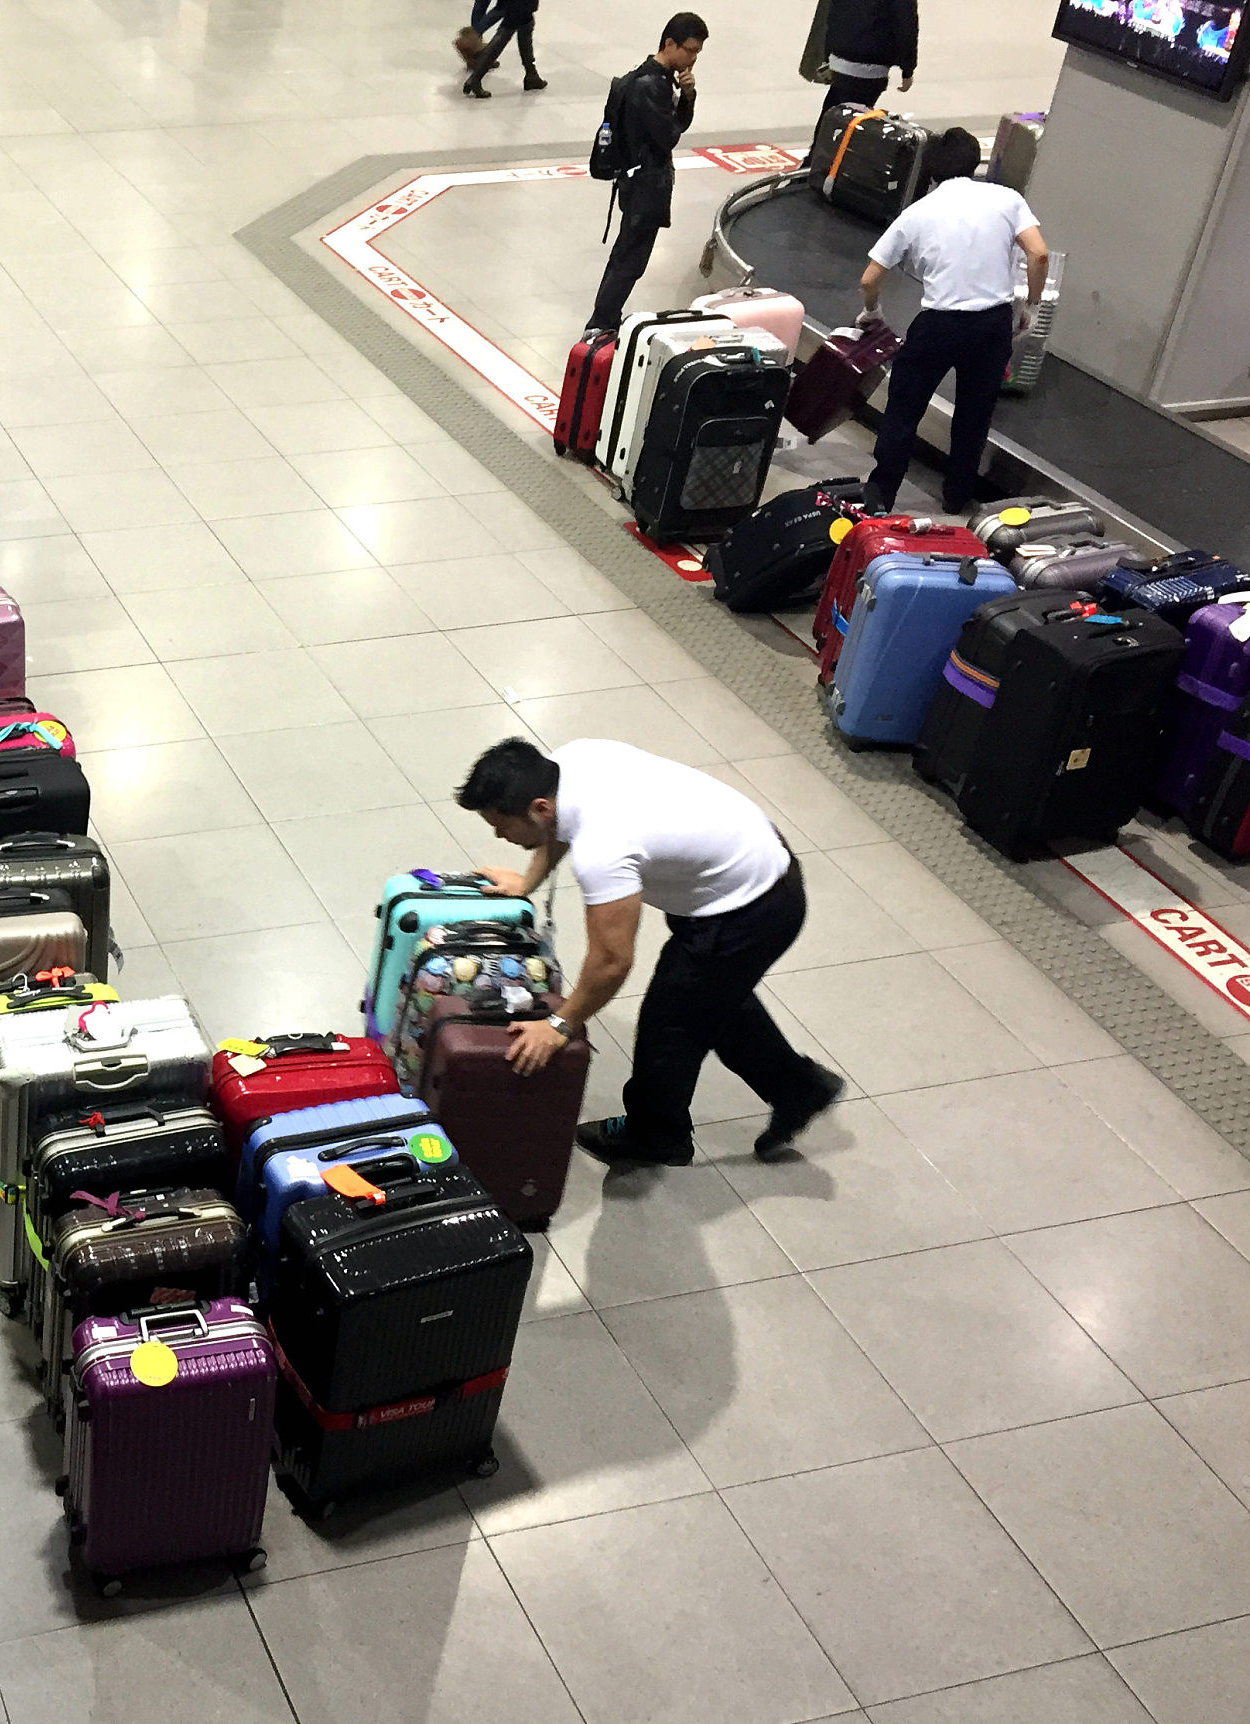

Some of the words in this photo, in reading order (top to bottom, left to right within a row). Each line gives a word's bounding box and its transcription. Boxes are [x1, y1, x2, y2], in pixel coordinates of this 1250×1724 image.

[368, 266, 408, 286] CART
[409, 301, 450, 323] カート
[1150, 908, 1248, 968] CART
